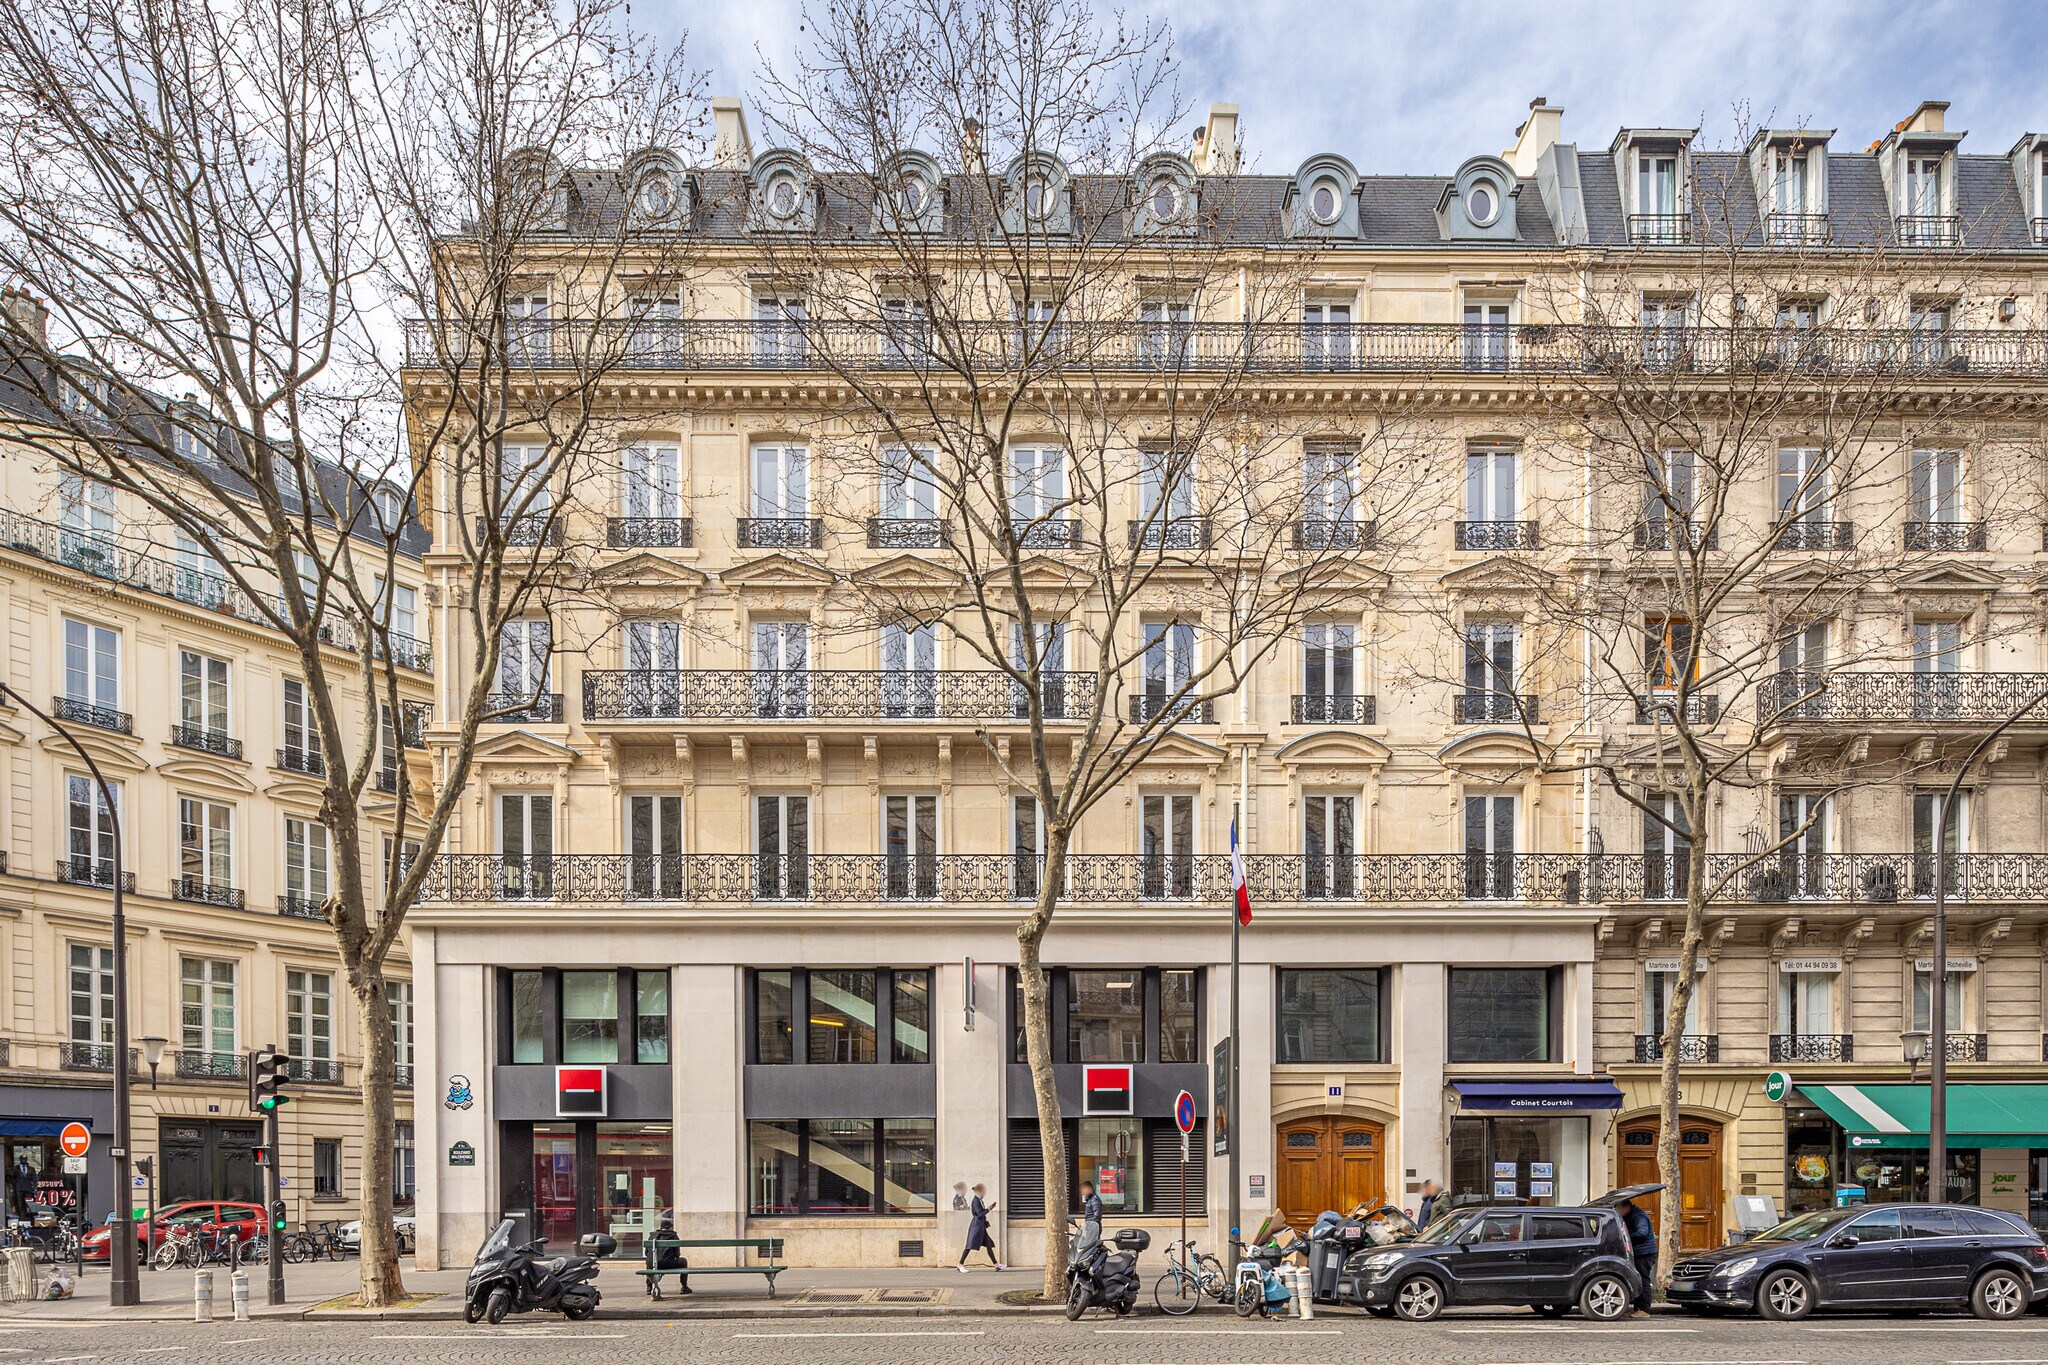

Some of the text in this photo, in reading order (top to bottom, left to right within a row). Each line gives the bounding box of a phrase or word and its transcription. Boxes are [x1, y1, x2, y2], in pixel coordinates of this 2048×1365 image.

[1768, 1082, 1782, 1092] jour
[1992, 1172, 2016, 1184] jour
[25, 1190, 76, 1206] -40%
